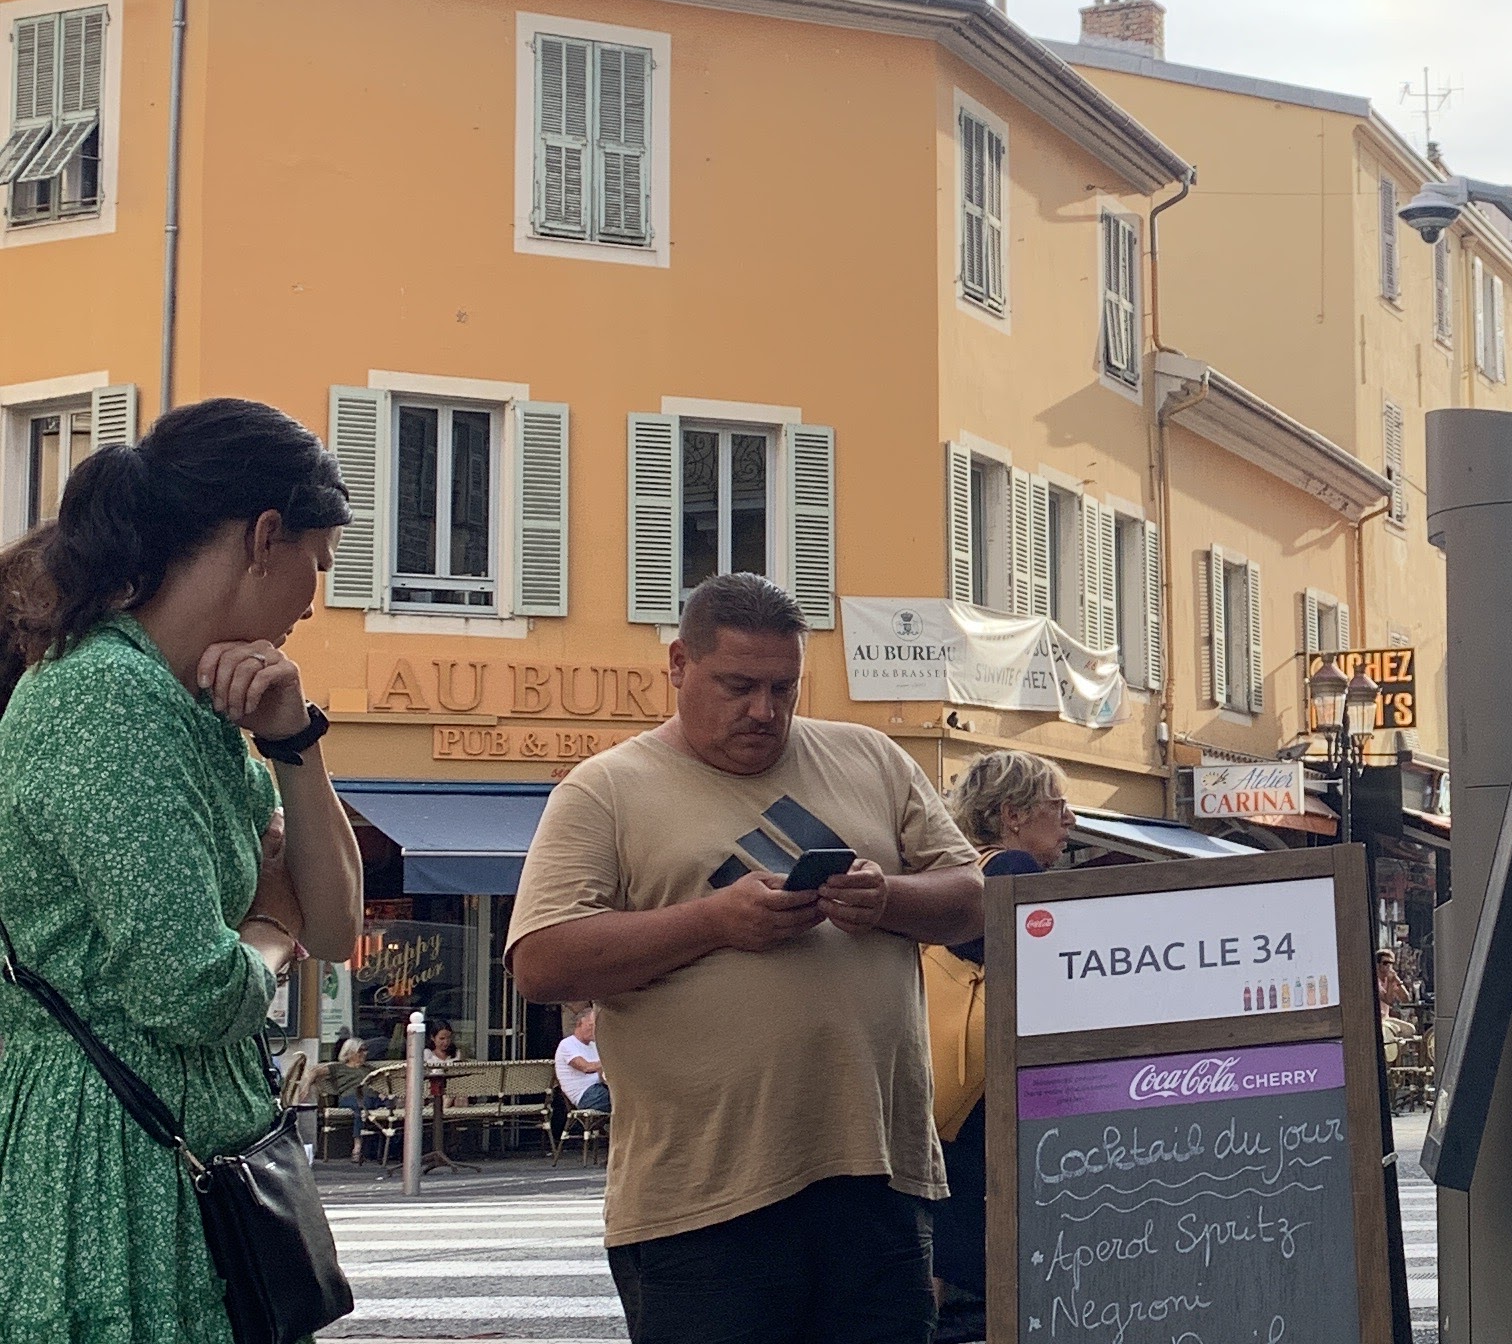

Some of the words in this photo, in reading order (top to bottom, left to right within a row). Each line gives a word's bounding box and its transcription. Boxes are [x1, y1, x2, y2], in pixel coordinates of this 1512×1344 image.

[853, 644, 880, 661] AU
[373, 658, 488, 713] AU
[508, 663, 677, 718] BUR
[438, 729, 510, 756] PUB
[520, 732, 549, 757] &
[1231, 767, 1294, 790] Atelier
[1200, 791, 1297, 814] CARINA
[356, 933, 443, 983] Happy
[1059, 942, 1186, 980] TABAC
[1199, 937, 1241, 969] LE
[1252, 932, 1296, 965] 34
[374, 960, 445, 1007] Hour
[1129, 1056, 1241, 1101] Coca-Cola
[1243, 1068, 1319, 1090] CHERRY
[1035, 1122, 1206, 1185] Cocktail
[1214, 1116, 1272, 1159] du
[1261, 1114, 1345, 1185] jour
[1045, 1219, 1159, 1292] Aperol
[1175, 1205, 1312, 1268] Spritz
